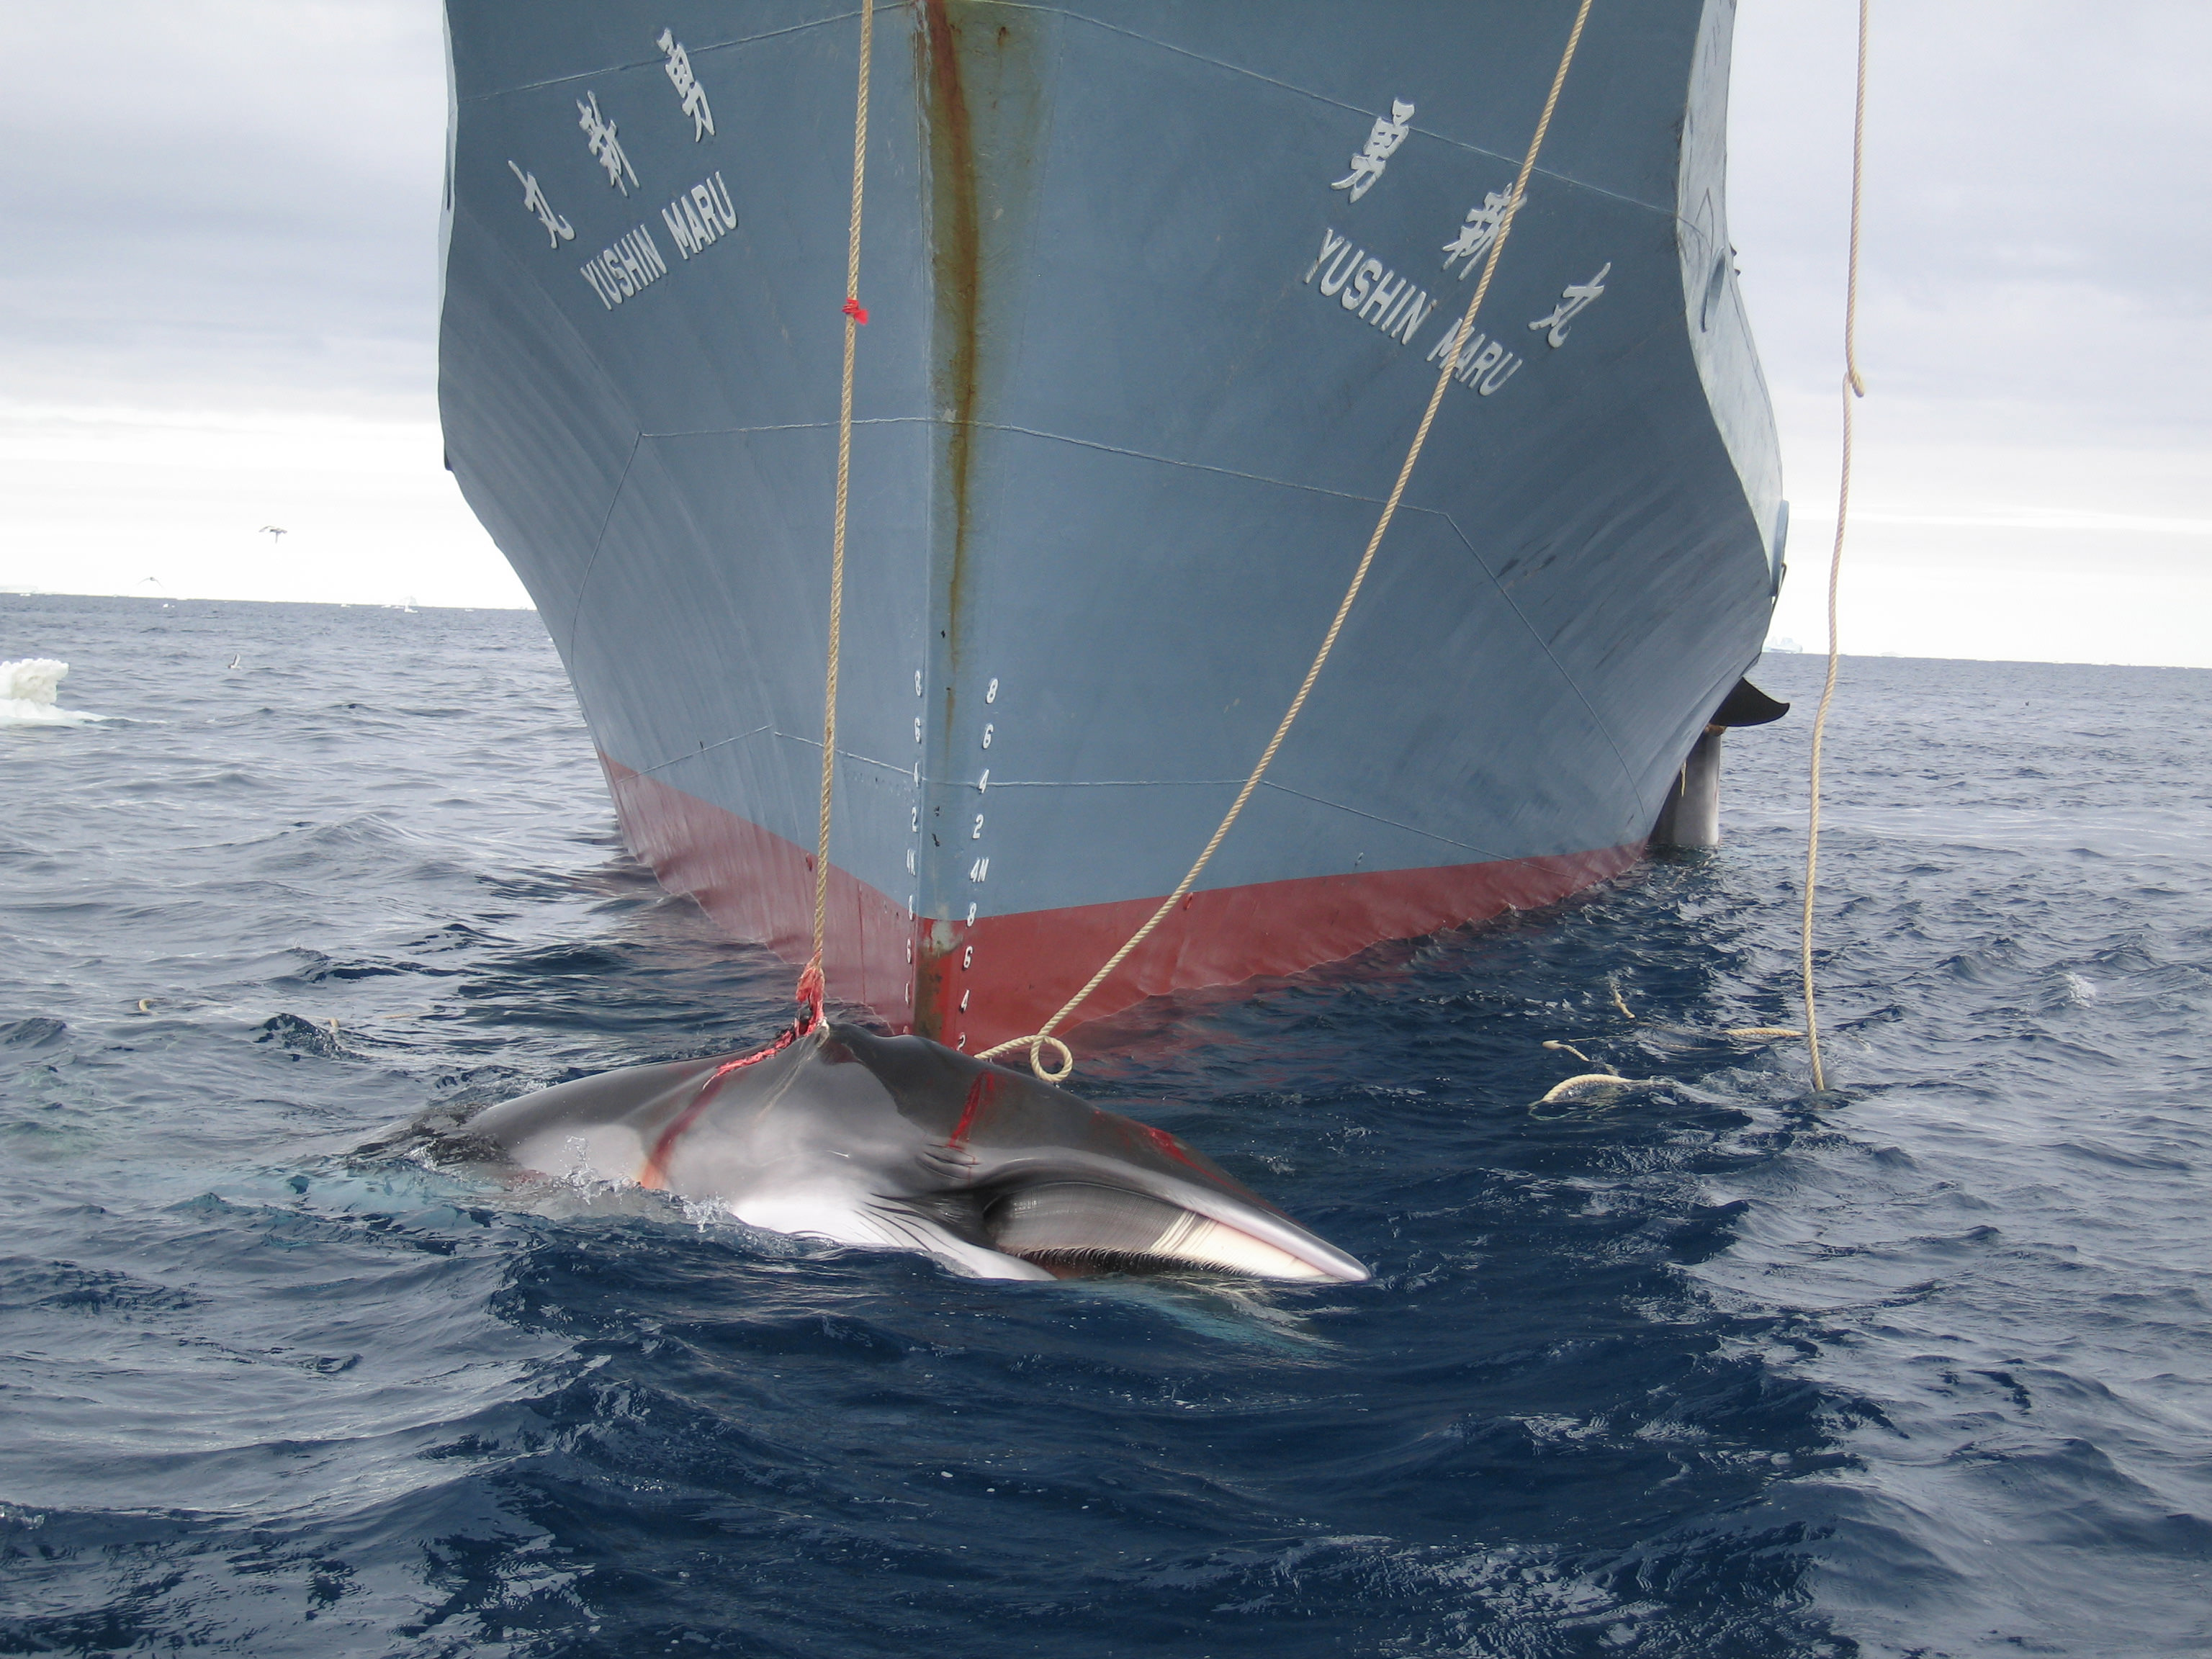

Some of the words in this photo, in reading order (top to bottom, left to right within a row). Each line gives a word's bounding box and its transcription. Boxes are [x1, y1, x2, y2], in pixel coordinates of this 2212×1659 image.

[580, 223, 667, 310] YUSHIN
[662, 170, 738, 260] MARU
[1303, 228, 1438, 346] YUSHIN
[1426, 318, 1524, 397] MARU
[914, 670, 922, 696] 8
[986, 678, 999, 703] 8
[914, 717, 921, 743] 6
[982, 723, 994, 749] 6
[979, 768, 990, 793] 4
[911, 806, 917, 832] 2
[972, 814, 984, 839] 2
[970, 857, 989, 882] 4M
[966, 902, 977, 927] 8
[906, 938, 912, 963] 6
[963, 945, 973, 969] 6
[961, 989, 970, 1011] 4
